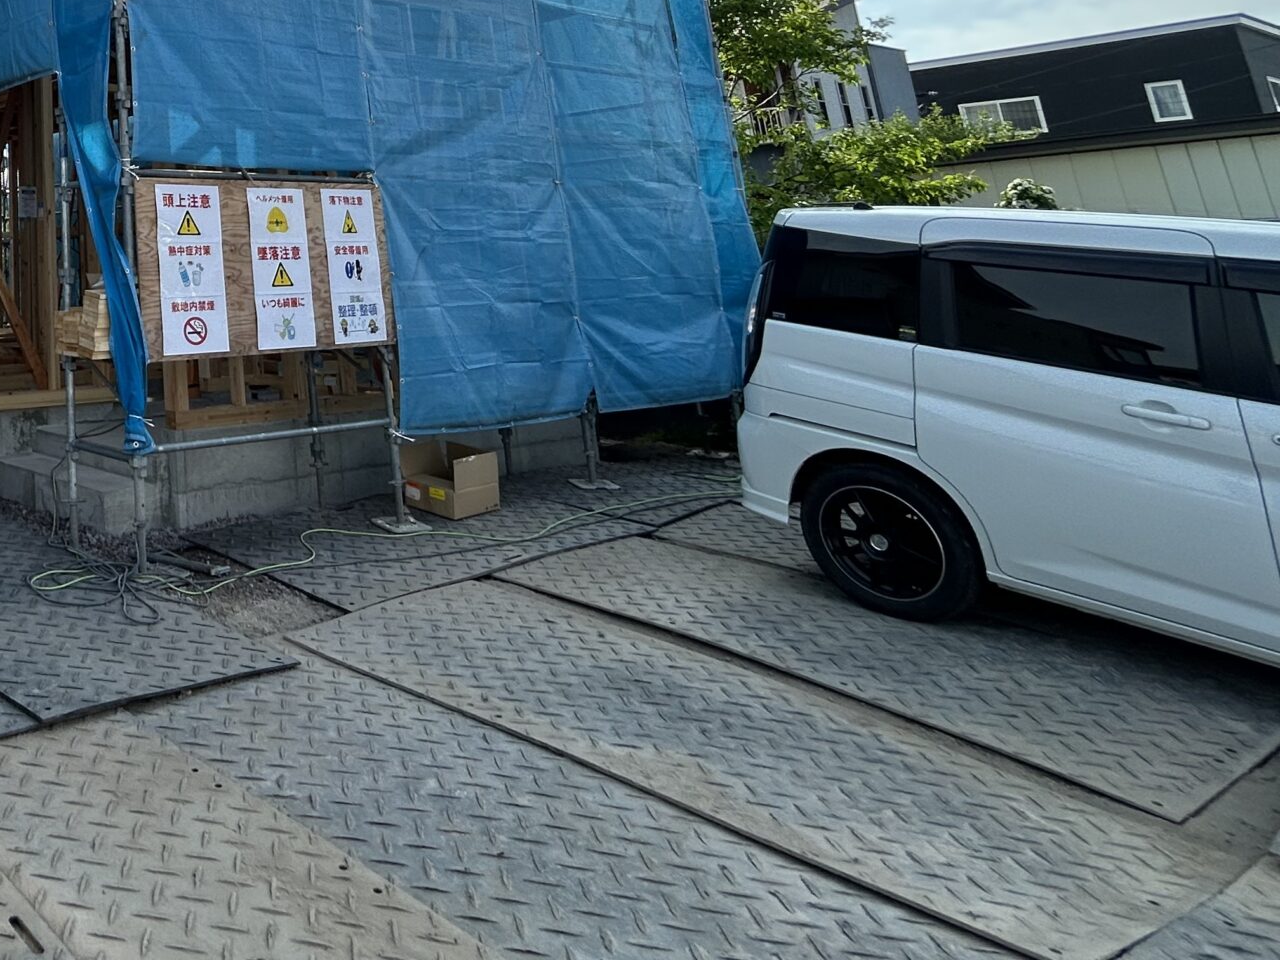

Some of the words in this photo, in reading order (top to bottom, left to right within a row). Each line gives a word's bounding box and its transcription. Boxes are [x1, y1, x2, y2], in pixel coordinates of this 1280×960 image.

[162, 193, 212, 209] 頭上注意
[168, 245, 212, 256] 熱中症対策
[257, 246, 302, 261] 墜落注意
[171, 301, 215, 313] 敷地内禁煙
[261, 297, 305, 308] いつも綺麗に
[338, 303, 378, 318] 整理・整頓
